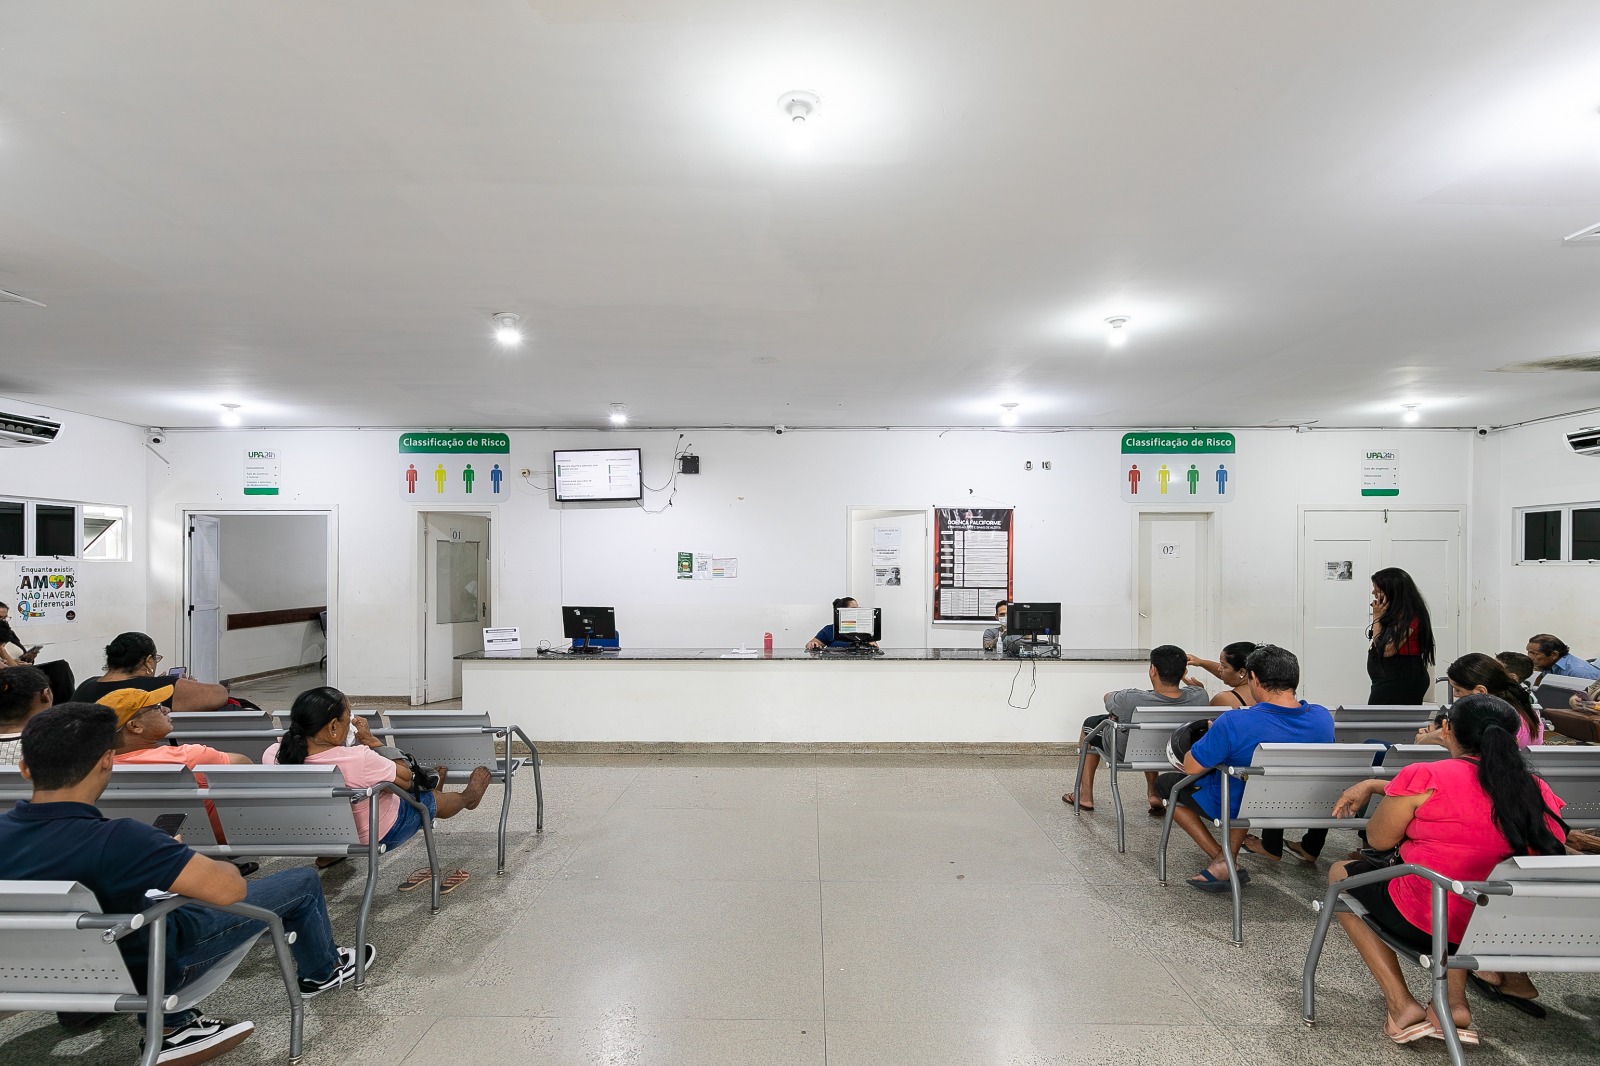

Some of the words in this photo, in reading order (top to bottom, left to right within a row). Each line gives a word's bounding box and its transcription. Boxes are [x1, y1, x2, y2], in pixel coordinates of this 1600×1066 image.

[403, 438, 464, 449] Classificação
[466, 438, 478, 447] de
[481, 438, 506, 447] Risco
[1125, 438, 1189, 449] Classificação
[1191, 438, 1204, 447] de
[1206, 438, 1232, 447] Risco
[452, 530, 461, 540] 01
[1162, 545, 1174, 555] 02
[21, 566, 53, 574] Enquanto
[21, 590, 41, 600] NÃO
[42, 589, 76, 599] HAVERÁ
[32, 599, 76, 609] diferenças!
